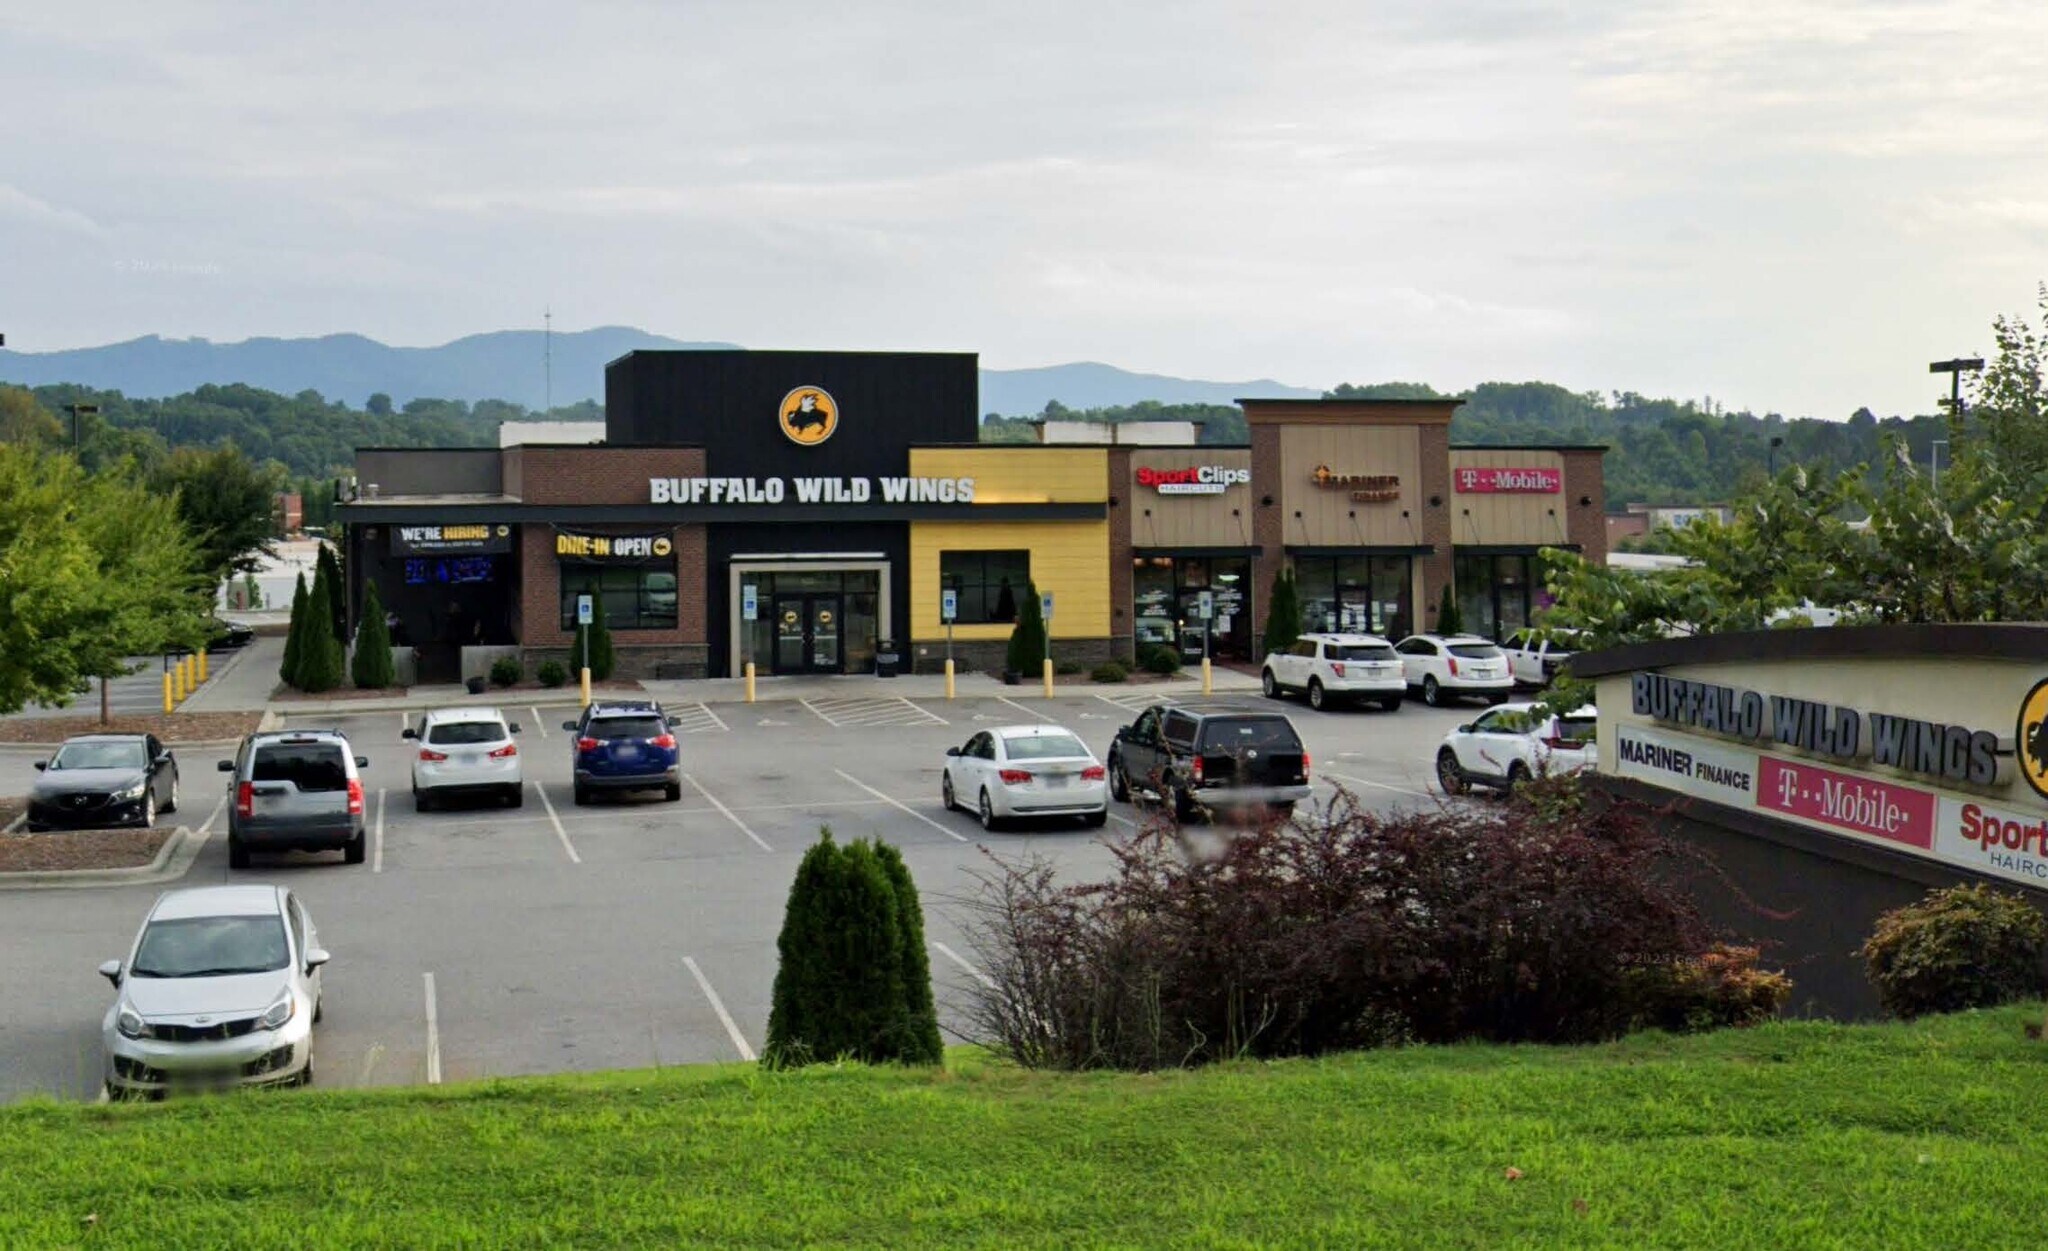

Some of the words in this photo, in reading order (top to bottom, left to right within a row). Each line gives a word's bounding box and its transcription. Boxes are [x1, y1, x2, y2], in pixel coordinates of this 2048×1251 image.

[650, 478, 784, 503] BUFFALO
[794, 478, 870, 502] WILD
[879, 478, 974, 502] WINGS
[402, 527, 441, 540] WE'RE
[443, 525, 489, 540] HIRING
[614, 538, 651, 556] OPEN
[1632, 672, 1763, 740] BUFFALO
[1770, 695, 1859, 757] WILD
[1869, 712, 1998, 785] WINGS
[1620, 738, 1693, 776] MARINER
[1696, 762, 1751, 791] FINANCE
[1960, 803, 2048, 858] Sport
[1990, 852, 2048, 878] HAIRC
